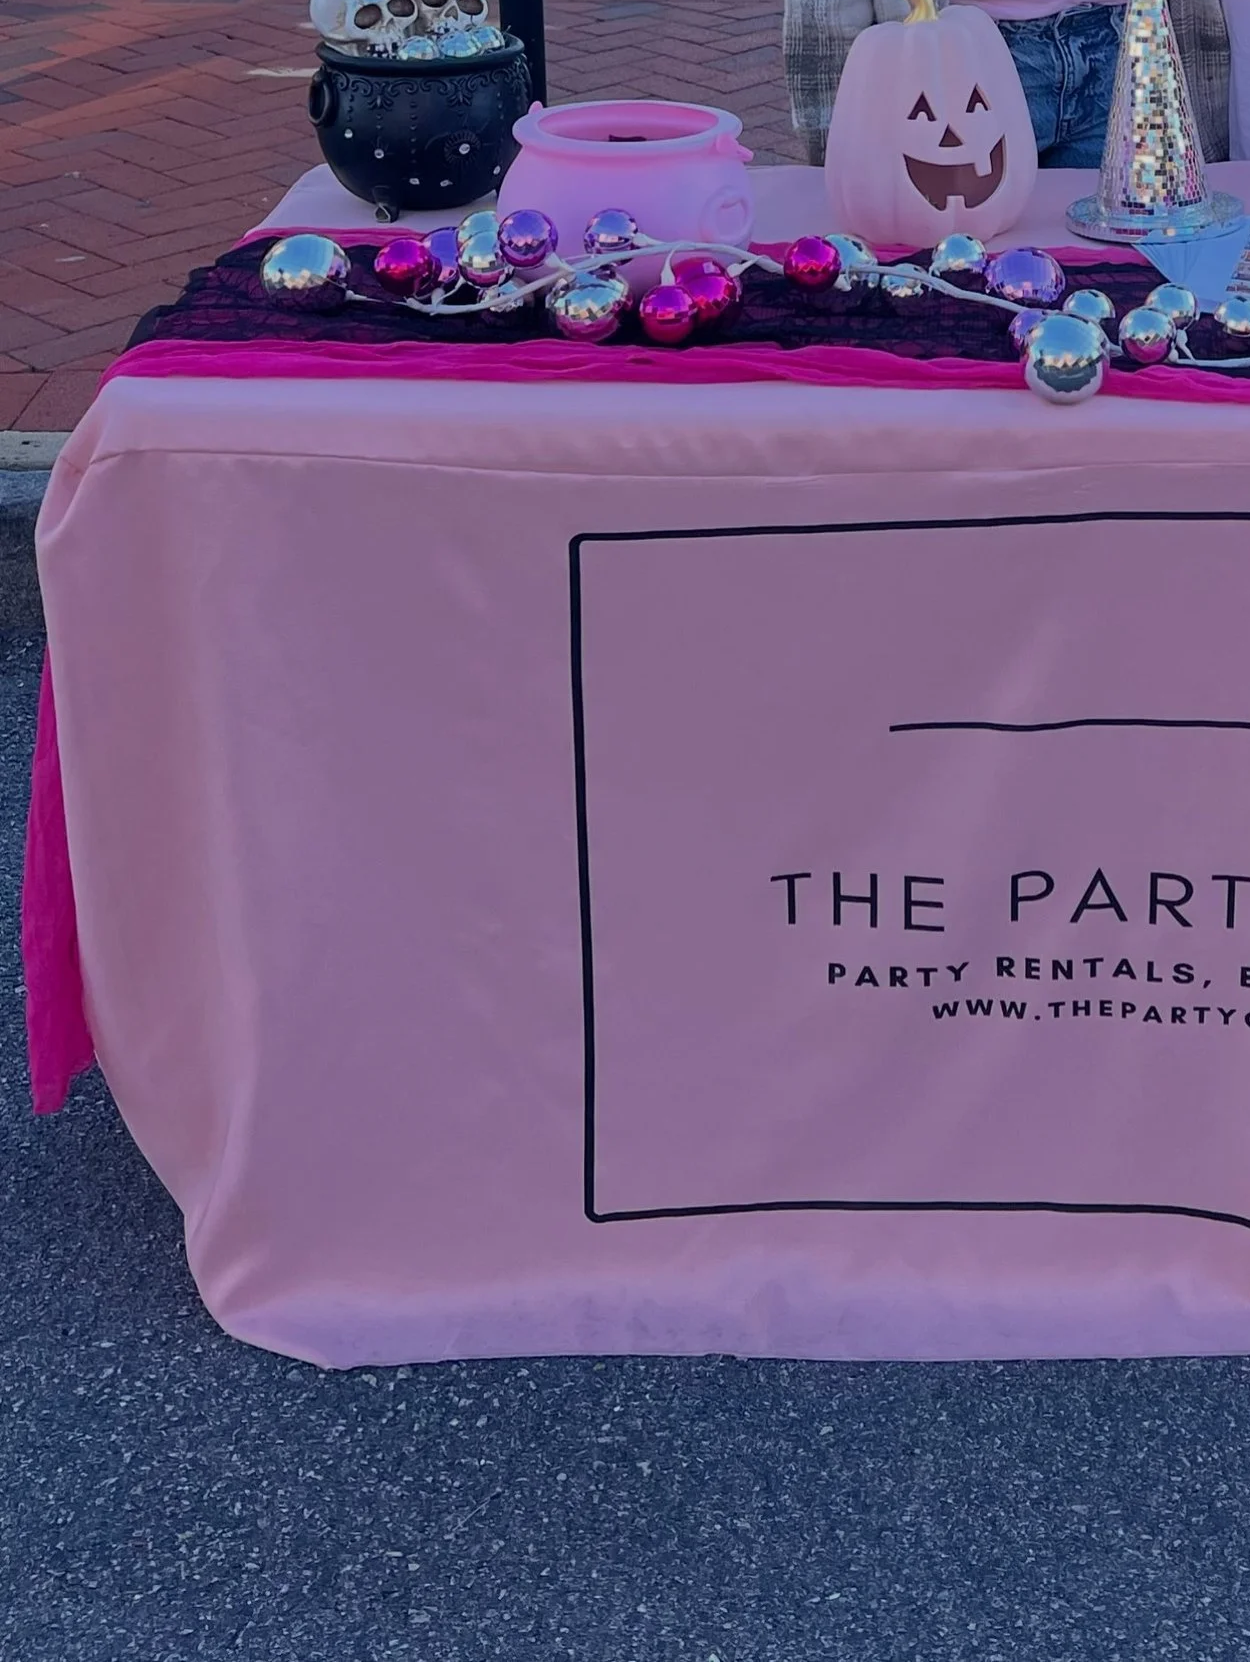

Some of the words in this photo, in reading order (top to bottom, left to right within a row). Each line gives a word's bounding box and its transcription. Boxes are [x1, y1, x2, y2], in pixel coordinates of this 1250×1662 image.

[770, 872, 945, 933] THE
[828, 961, 970, 988] PARTY
[996, 956, 1212, 989] RENTALS,
